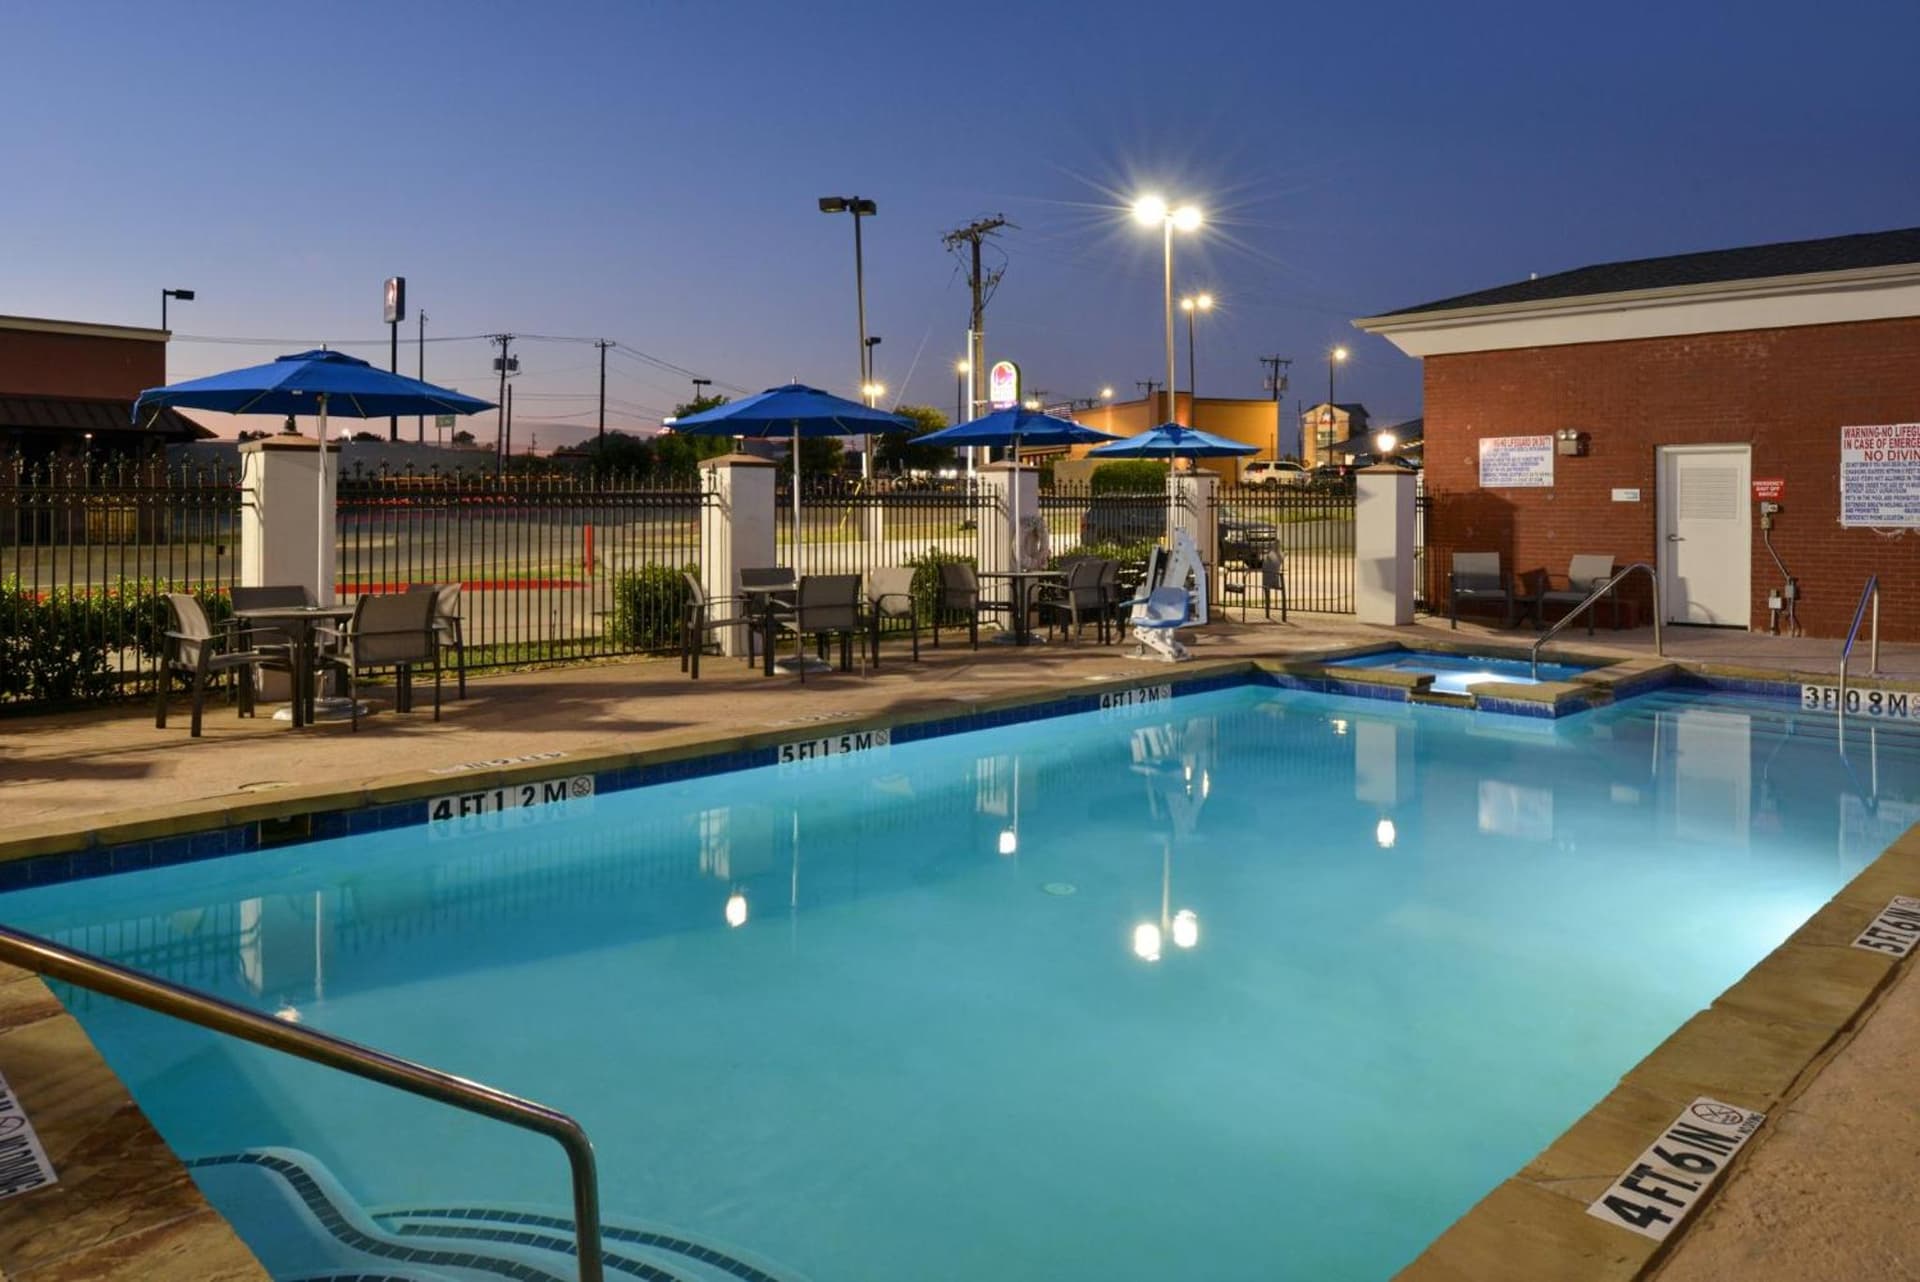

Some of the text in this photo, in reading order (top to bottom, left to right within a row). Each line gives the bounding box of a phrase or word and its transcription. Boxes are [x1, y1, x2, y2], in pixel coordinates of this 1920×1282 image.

[1844, 439, 1852, 449] IN
[1854, 439, 1874, 449] CASE
[1876, 438, 1888, 449] OF
[1864, 450, 1884, 461] NO
[459, 794, 486, 818] FT
[543, 781, 568, 804] M
